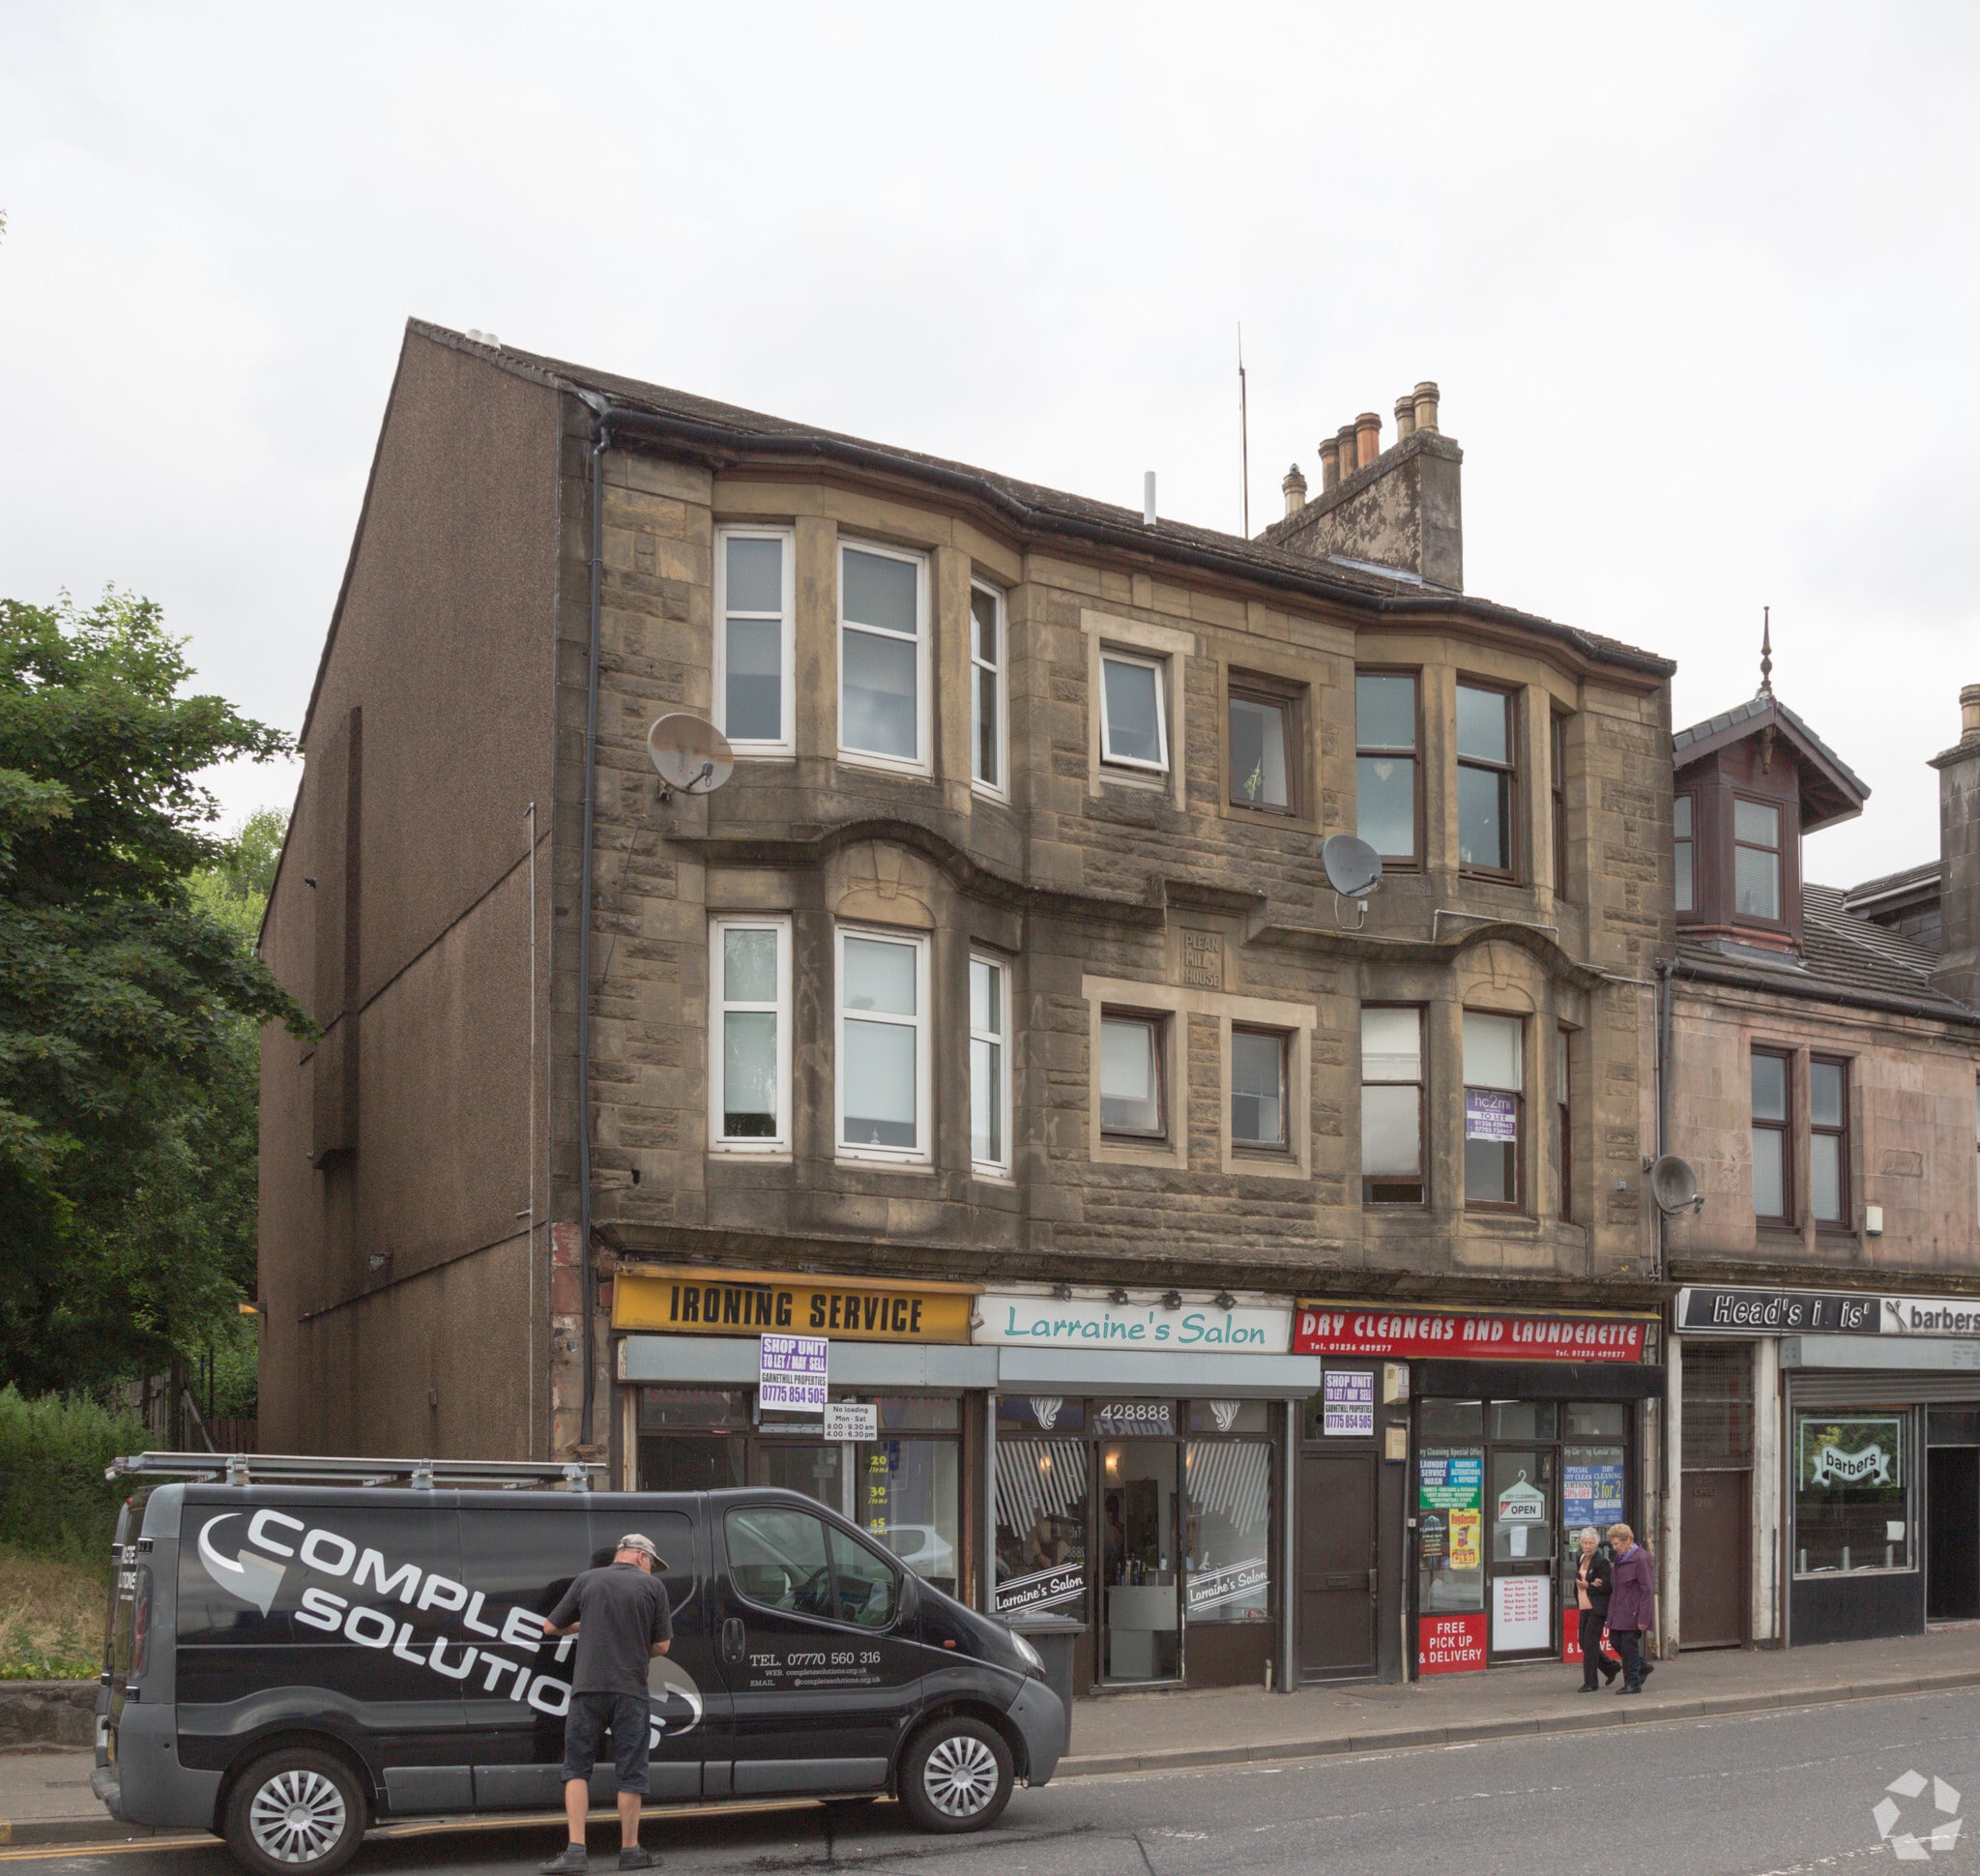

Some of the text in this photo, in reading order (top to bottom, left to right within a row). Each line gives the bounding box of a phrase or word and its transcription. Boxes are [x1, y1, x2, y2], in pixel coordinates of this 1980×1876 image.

[1185, 934, 1218, 953] PLEAN
[1185, 952, 1208, 969] MILL
[1185, 969, 1219, 986] HOUSE
[670, 1285, 922, 1333] IRONING SERVICE
[1712, 1295, 1802, 1326] Head's
[1005, 1306, 1266, 1344] Larraine's Salon
[1911, 1305, 1980, 1331] barbers
[1302, 1313, 1638, 1345] DRY CLEANERS AND LAUNDERETTE
[764, 1338, 826, 1356] SHOP UNIT
[764, 1354, 772, 1368] TO
[773, 1354, 786, 1369] LET
[792, 1356, 807, 1370] MAY
[809, 1357, 825, 1371] SELL
[762, 1372, 827, 1386] GARNETHILL PROPERTIES
[1326, 1375, 1371, 1388] SHOP UNIT
[762, 1385, 825, 1403] 07775 854 505
[1326, 1389, 1333, 1399] TO
[1334, 1389, 1343, 1399] LET
[1347, 1389, 1358, 1400] MAY
[1359, 1390, 1371, 1400] SELL
[1100, 1404, 1169, 1420] 428888
[1325, 1415, 1371, 1428] 07775 854 505
[870, 1455, 887, 1465] 20
[1826, 1451, 1876, 1475] barbers
[870, 1486, 886, 1497] 30
[1594, 1480, 1621, 1499] 3 for 2
[1511, 1506, 1536, 1514] OPEN
[870, 1517, 886, 1528] 45
[248, 1509, 580, 1662] COMPLET
[996, 1574, 1083, 1610] Larraine's Salon
[1190, 1569, 1267, 1602] Larraine's Salon
[1438, 1622, 1465, 1634] FREE
[1430, 1635, 1472, 1649] PICK UP
[1567, 1643, 1573, 1654] &
[750, 1651, 881, 1666] TEL. 07770 560 316
[1419, 1649, 1482, 1663] & DELIVERY
